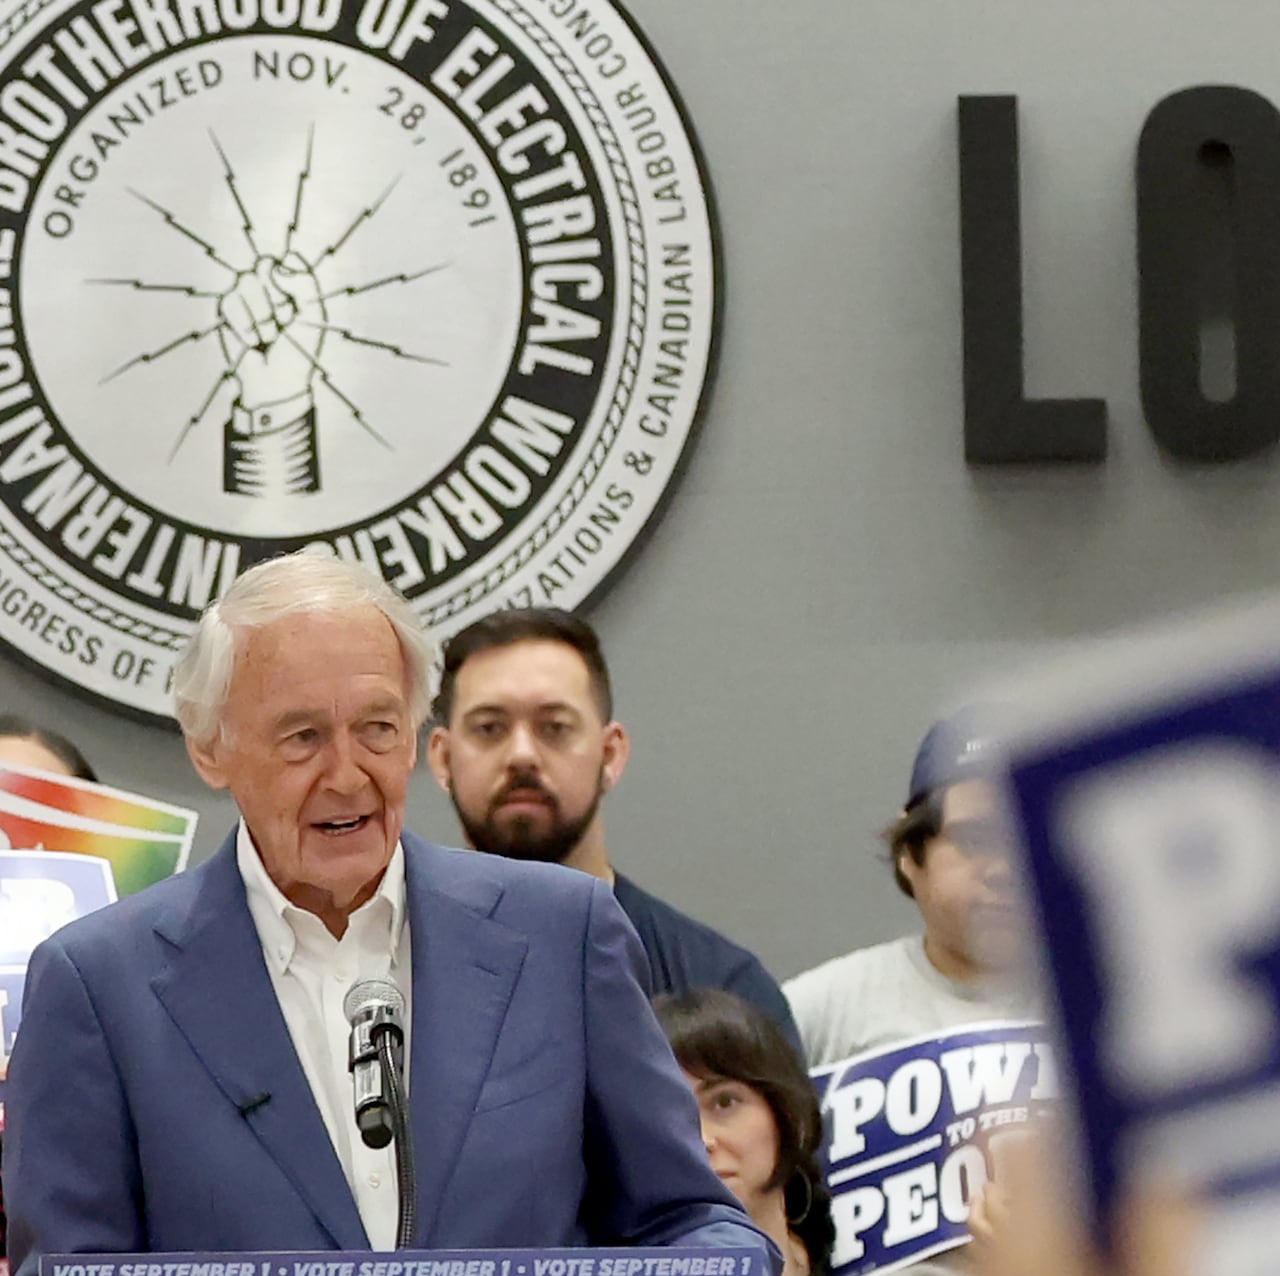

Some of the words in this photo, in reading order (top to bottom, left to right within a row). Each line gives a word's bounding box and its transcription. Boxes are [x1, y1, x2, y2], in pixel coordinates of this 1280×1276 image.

[43, 59, 222, 239] ORGANIZED
[253, 51, 351, 95] NOV.
[377, 87, 427, 146] 28,
[438, 147, 498, 228] 1891
[355, 0, 451, 61] OF
[429, 25, 605, 377] ELECTRICAL
[615, 81, 688, 226] LABOUR
[638, 243, 693, 438] CANADIAN
[624, 449, 655, 477] &
[110, 649, 157, 688] OF
[945, 1117, 977, 1148] TO
[978, 1106, 1030, 1133] THE
[739, 1255, 752, 1276] 1
